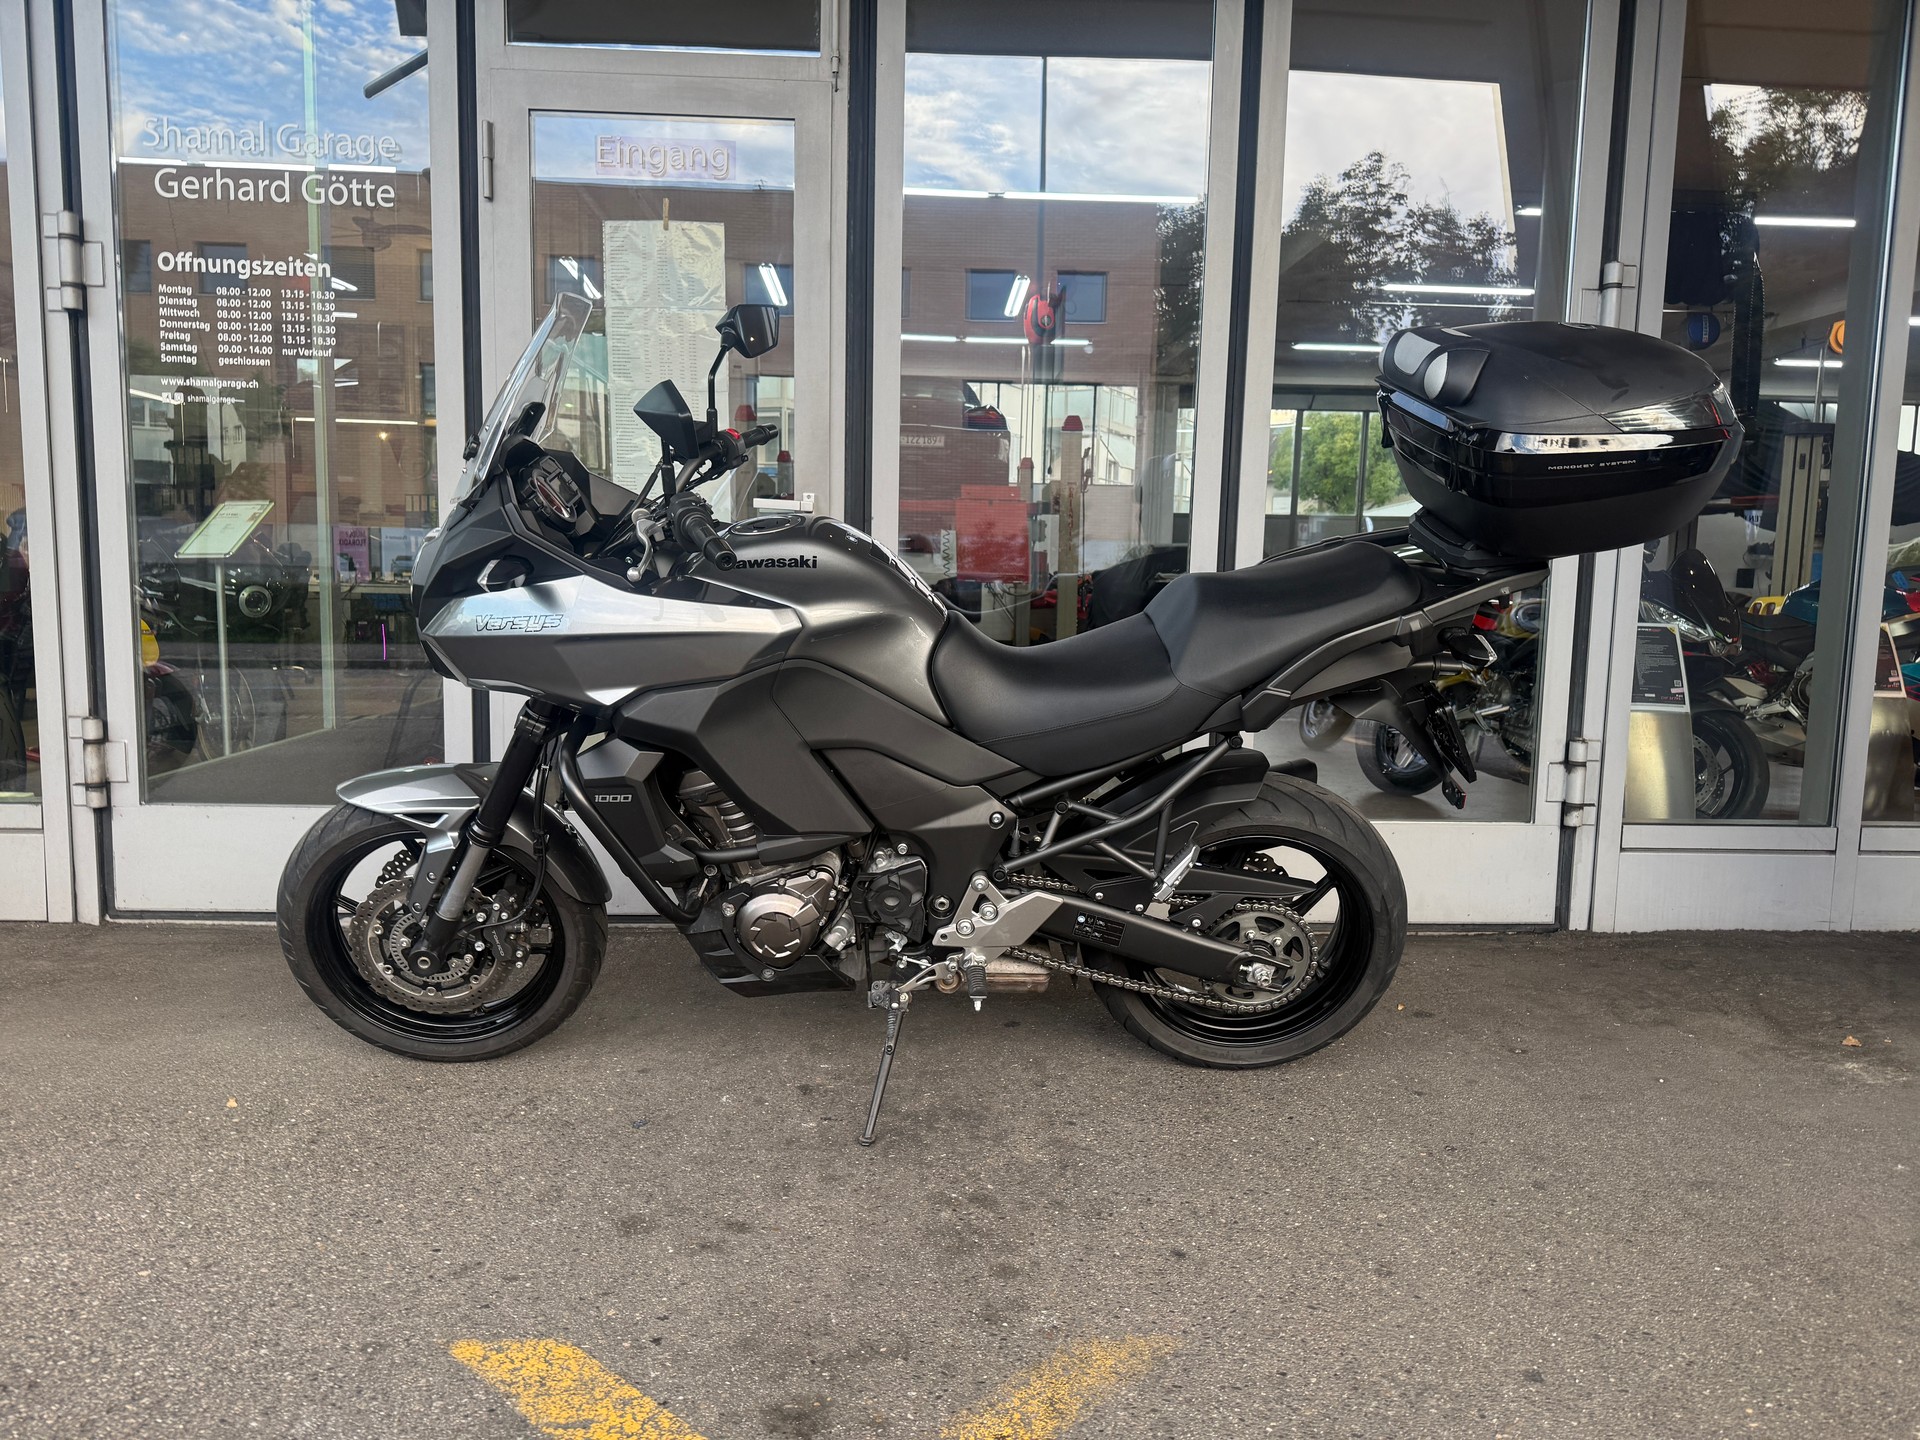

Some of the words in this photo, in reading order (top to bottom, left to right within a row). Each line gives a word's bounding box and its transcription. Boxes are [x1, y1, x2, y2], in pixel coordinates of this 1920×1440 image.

[143, 116, 265, 152] Shamal
[276, 123, 397, 164] Garage
[596, 135, 730, 180] Eingang
[154, 167, 290, 203] Gerhard
[301, 173, 395, 208] Götte
[158, 284, 192, 296] Montag
[216, 287, 241, 296] 08.00
[248, 288, 271, 297] 12.00
[281, 289, 304, 298] 13.15
[312, 291, 335, 300] 18.30
[159, 296, 198, 307] Dienstag
[216, 299, 241, 308] 08.00
[248, 300, 271, 309] 12.00
[281, 301, 304, 310] 13.15
[312, 302, 335, 311] 18.30
[159, 308, 200, 318] Mittwoch
[217, 310, 241, 319] 08.00
[249, 311, 272, 320] 12.00
[282, 312, 305, 321] 13.15
[312, 314, 336, 323] 18.30
[159, 319, 210, 332] Donnerstag
[217, 322, 241, 331] 08.00
[249, 323, 272, 332] 12.00
[282, 324, 305, 333] 13.15
[313, 325, 336, 334] 18.30
[160, 331, 191, 342] Freitag
[218, 333, 242, 342] 08.00
[249, 334, 272, 343] 12.00
[283, 336, 306, 345] 13.15
[313, 337, 336, 346] 18.30
[160, 342, 197, 353] Samstag
[218, 345, 242, 354] 09.00
[250, 346, 273, 355] 14.00
[299, 347, 332, 357] Verkauf
[160, 354, 197, 365] Sonntag
[218, 356, 271, 367] geschlossen
[160, 377, 259, 389] www.shamalgarage.ch
[187, 394, 236, 404] shamalgarage
[1599, 459, 1637, 467] SYSTEM
[736, 555, 818, 569] awasaki
[475, 614, 564, 633] Versys
[594, 794, 632, 803] 1000
